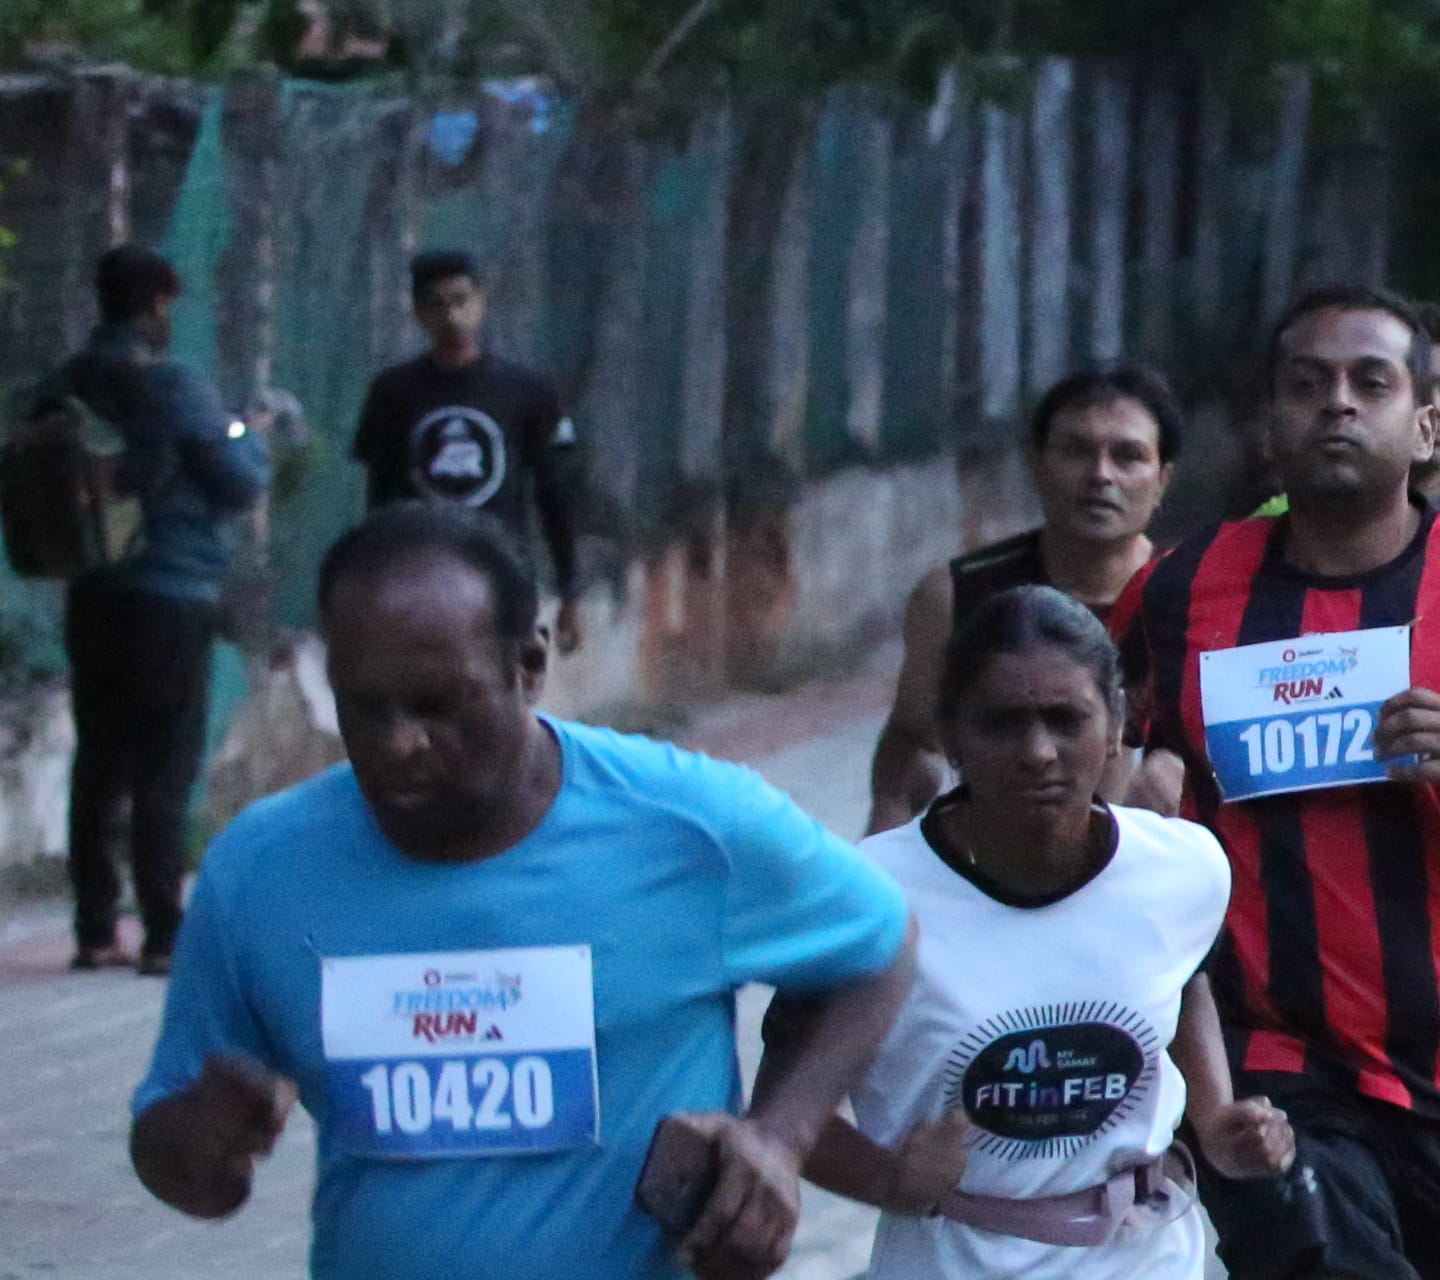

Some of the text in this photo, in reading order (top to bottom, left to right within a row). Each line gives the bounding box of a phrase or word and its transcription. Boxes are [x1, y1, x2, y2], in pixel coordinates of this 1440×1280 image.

[1258, 658, 1347, 684] FREEDOM
[1273, 677, 1325, 705] RUN
[1239, 708, 1375, 777] 10172
[393, 986, 508, 1013] FREEDOM
[412, 1010, 478, 1043] RUN
[360, 1055, 555, 1137] 10420
[975, 1073, 1128, 1110] FIT in FEB
